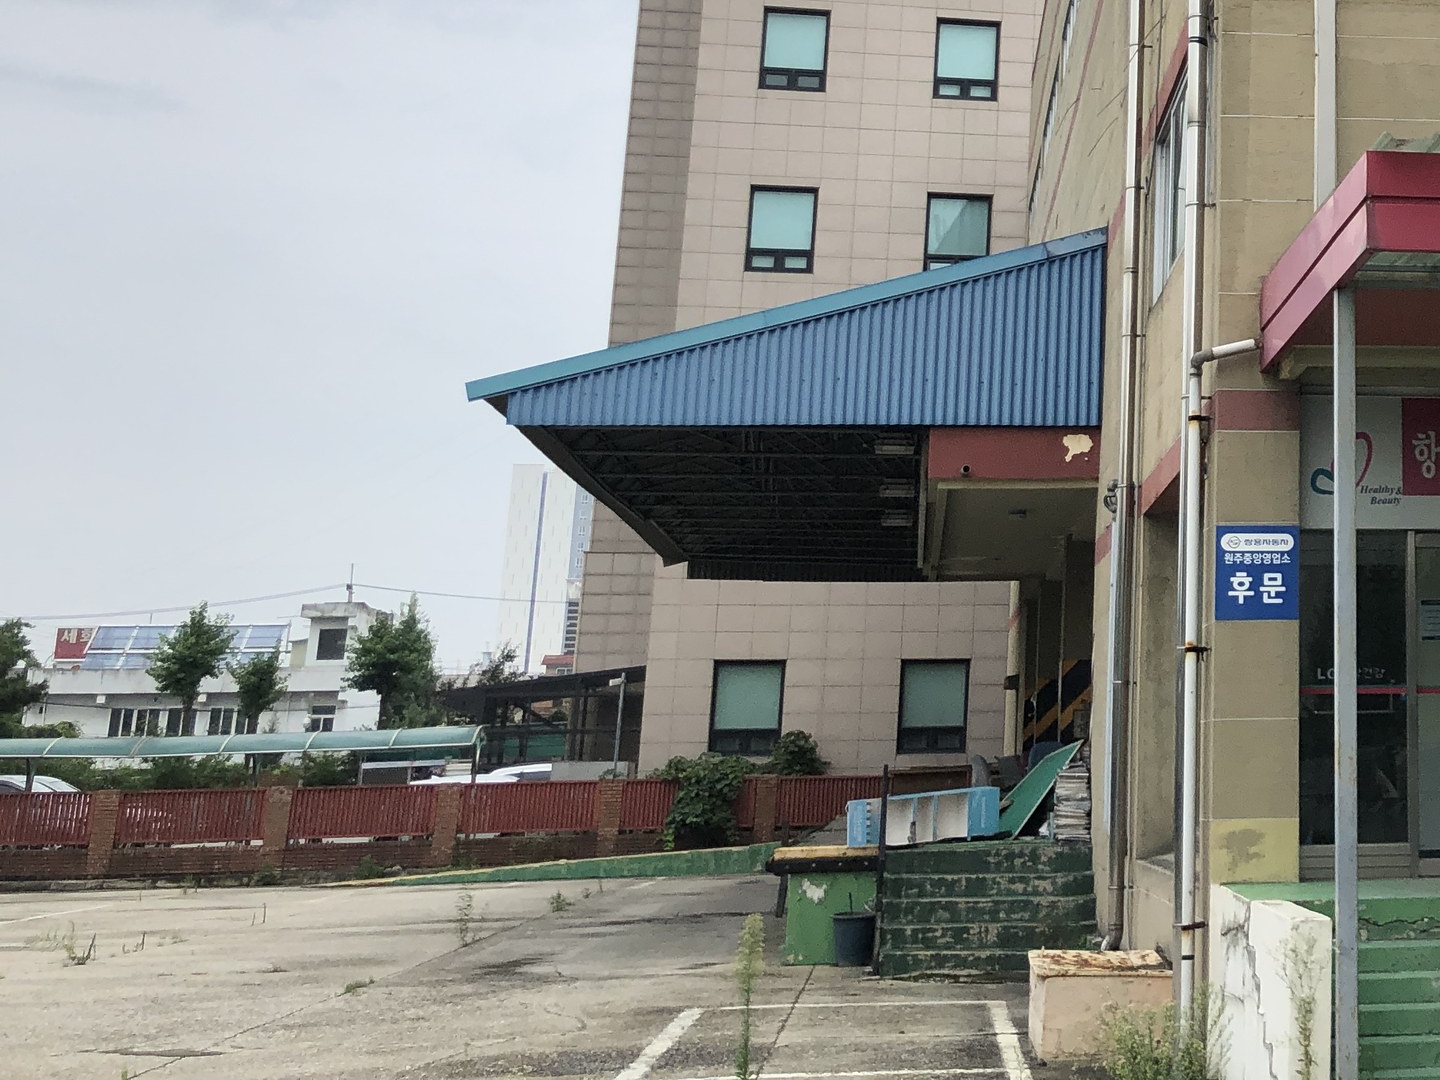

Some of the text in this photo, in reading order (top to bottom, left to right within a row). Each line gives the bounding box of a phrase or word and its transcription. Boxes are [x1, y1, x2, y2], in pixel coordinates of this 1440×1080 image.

[1370, 496, 1402, 507] Beauty
[1224, 552, 1291, 565] 원주중앙영업소
[1227, 571, 1287, 605] 후문
